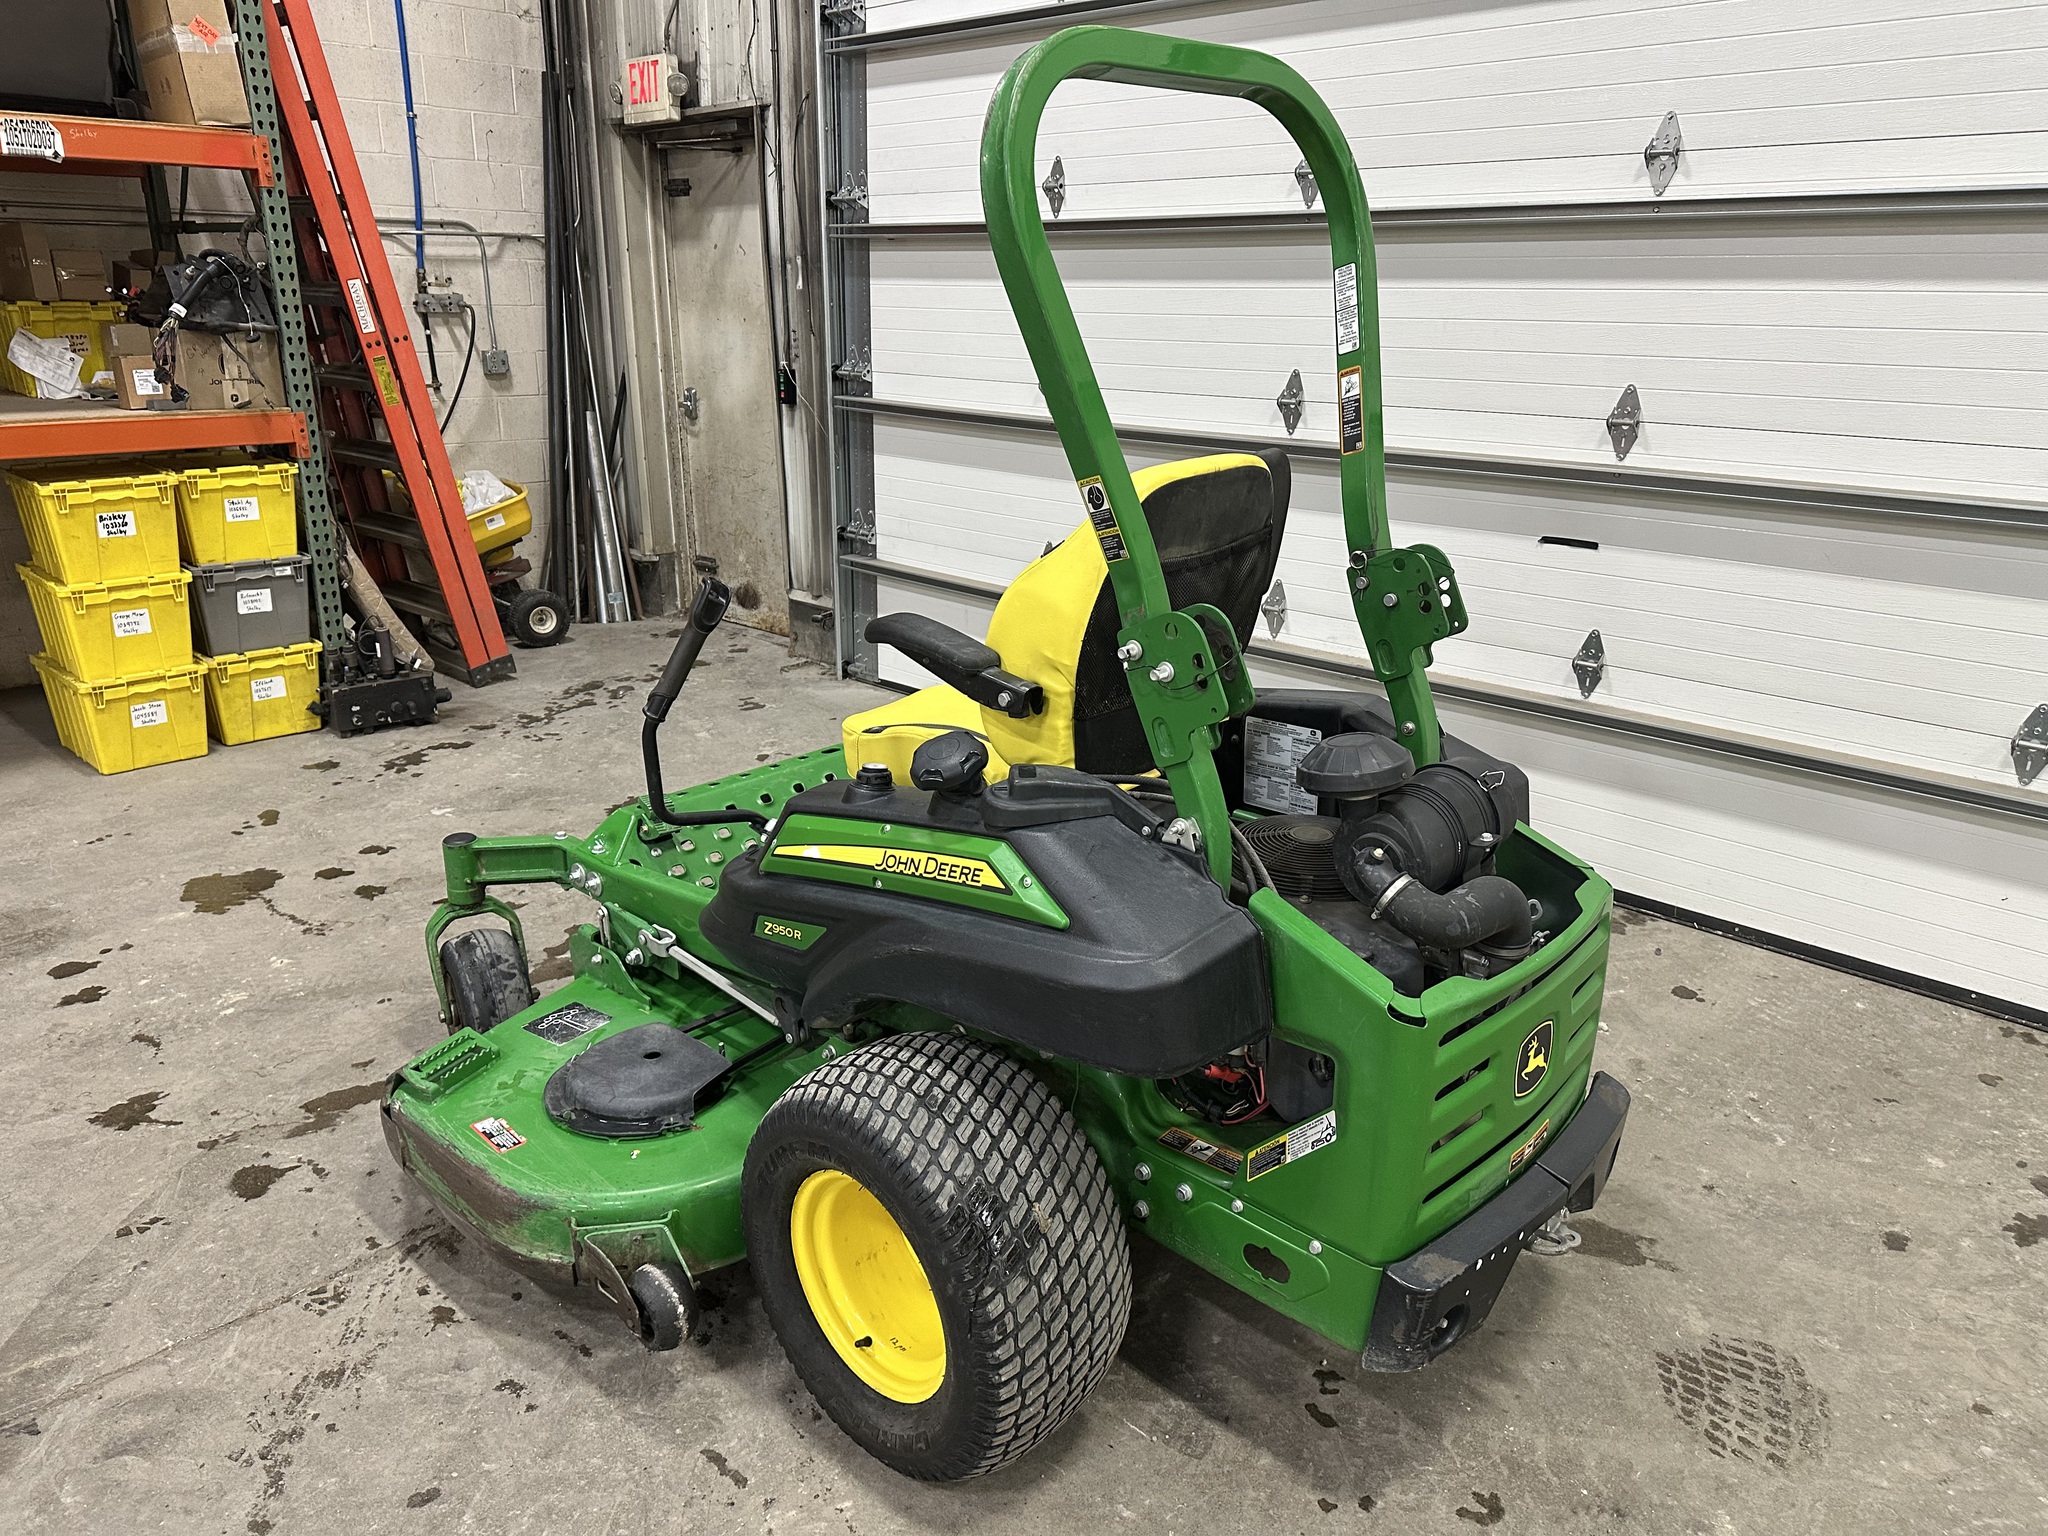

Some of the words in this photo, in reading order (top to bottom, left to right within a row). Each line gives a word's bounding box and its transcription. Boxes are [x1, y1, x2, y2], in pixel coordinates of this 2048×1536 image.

[629, 60, 659, 105] EXIT
[69, 128, 98, 139] Shelby
[350, 282, 371, 330] MICHIGAN
[875, 850, 922, 874] JOHN
[924, 857, 983, 884] DEERE
[763, 921, 802, 941] Z950R
